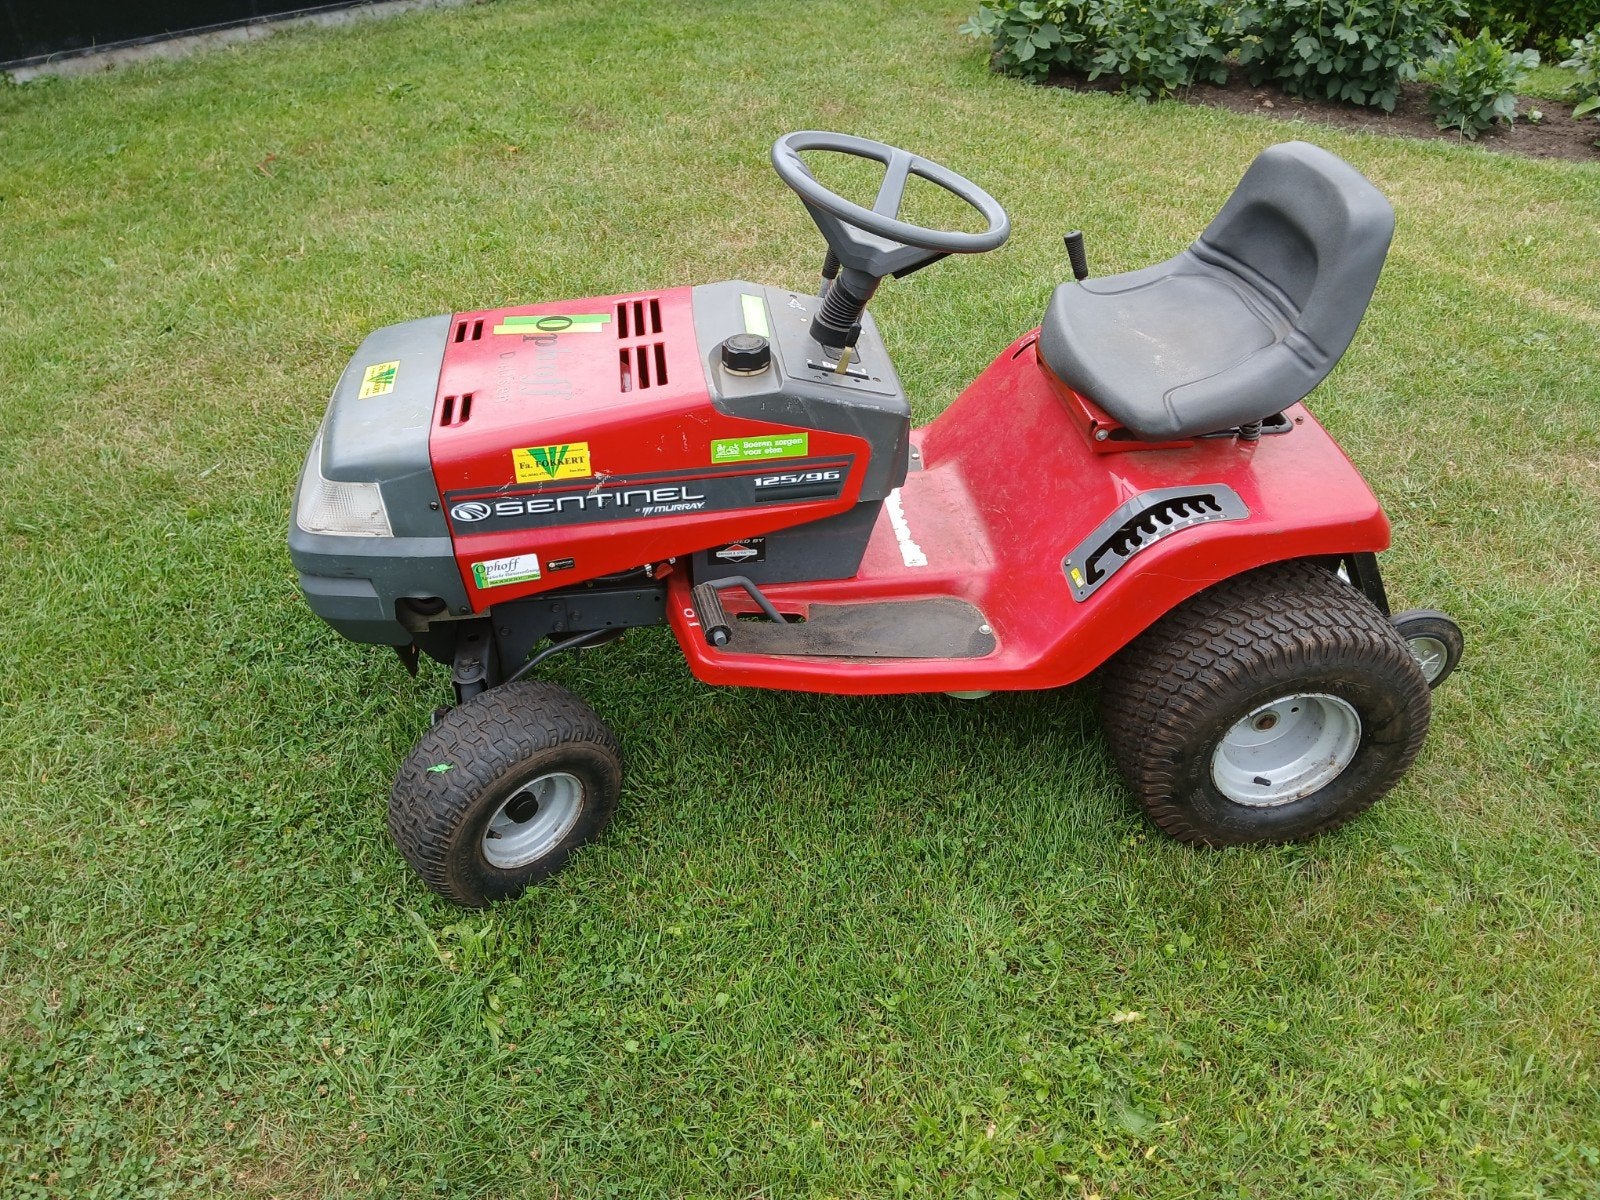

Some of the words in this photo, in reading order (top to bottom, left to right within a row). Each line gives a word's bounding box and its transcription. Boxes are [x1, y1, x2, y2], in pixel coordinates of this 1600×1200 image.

[743, 440, 772, 449] Boeren
[775, 438, 803, 447] zorgen
[519, 462, 533, 470] Fa.
[535, 456, 585, 468] FOKKERT
[754, 470, 840, 487] 125/96
[495, 486, 705, 516] SENTINEL
[654, 501, 706, 513] MURRAY
[475, 557, 520, 575] Ophoff
